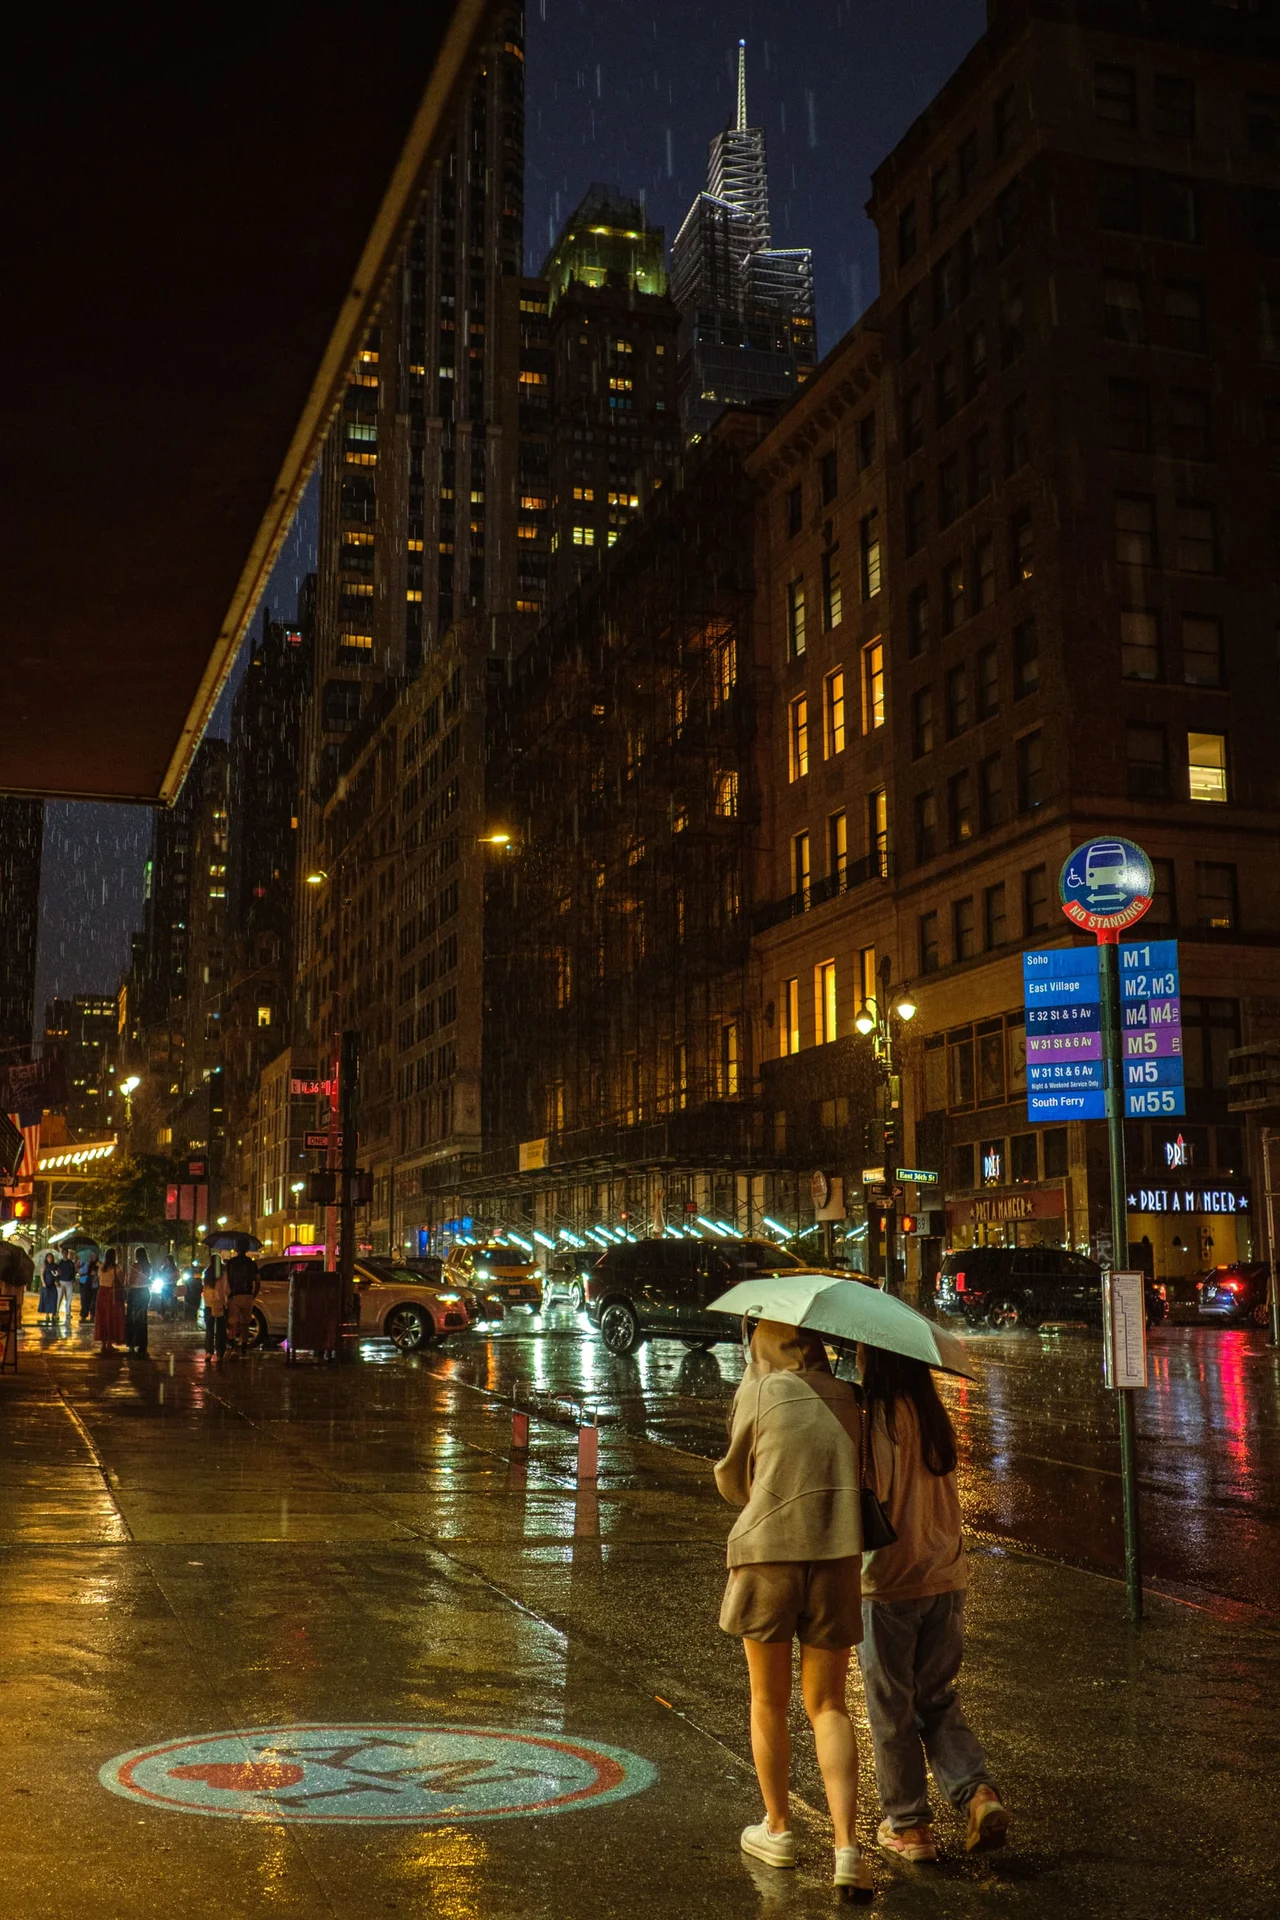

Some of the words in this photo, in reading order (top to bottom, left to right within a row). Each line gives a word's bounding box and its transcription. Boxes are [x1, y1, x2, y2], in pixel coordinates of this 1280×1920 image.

[1069, 905, 1086, 922] NO
[1088, 900, 1144, 929] STANDING
[1027, 955, 1049, 965] Soho
[1123, 946, 1150, 968] M1
[1029, 983, 1047, 993] East
[1050, 981, 1080, 992] Village
[1152, 973, 1175, 994] M3
[1029, 1012, 1034, 1021] E
[1037, 1011, 1048, 1021] 32
[1050, 1010, 1060, 1020] St
[1062, 1009, 1069, 1019] &
[1072, 1009, 1077, 1018] 5
[1080, 1008, 1091, 1018] Av
[1126, 1004, 1147, 1025] M4
[1150, 1002, 1171, 1024] M4
[1030, 1040, 1039, 1050] W
[1041, 1040, 1051, 1049] 31
[1054, 1039, 1063, 1048] St
[1065, 1038, 1071, 1048] &
[1073, 1037, 1079, 1047] 6
[1081, 1037, 1092, 1046] Av
[1128, 1032, 1158, 1054] M5
[1172, 1037, 1180, 1052] LTD
[1031, 1068, 1040, 1078] W
[1042, 1067, 1052, 1077] 31
[1054, 1067, 1064, 1077] St
[1065, 1066, 1072, 1076] &
[1074, 1066, 1080, 1076] 6
[1082, 1065, 1093, 1075] Av
[1129, 1061, 1158, 1083] M5
[1032, 1097, 1058, 1107] South
[1060, 1096, 1084, 1107] Ferry
[1130, 1090, 1175, 1113] M55
[310, 1137, 325, 1145] ONE
[975, 1200, 990, 1221] PRET
[991, 1199, 997, 1220] A
[998, 1197, 1026, 1219] MANGER
[1140, 1189, 1168, 1211] PRET
[1172, 1191, 1181, 1211] A
[1185, 1191, 1236, 1212] MANGER
